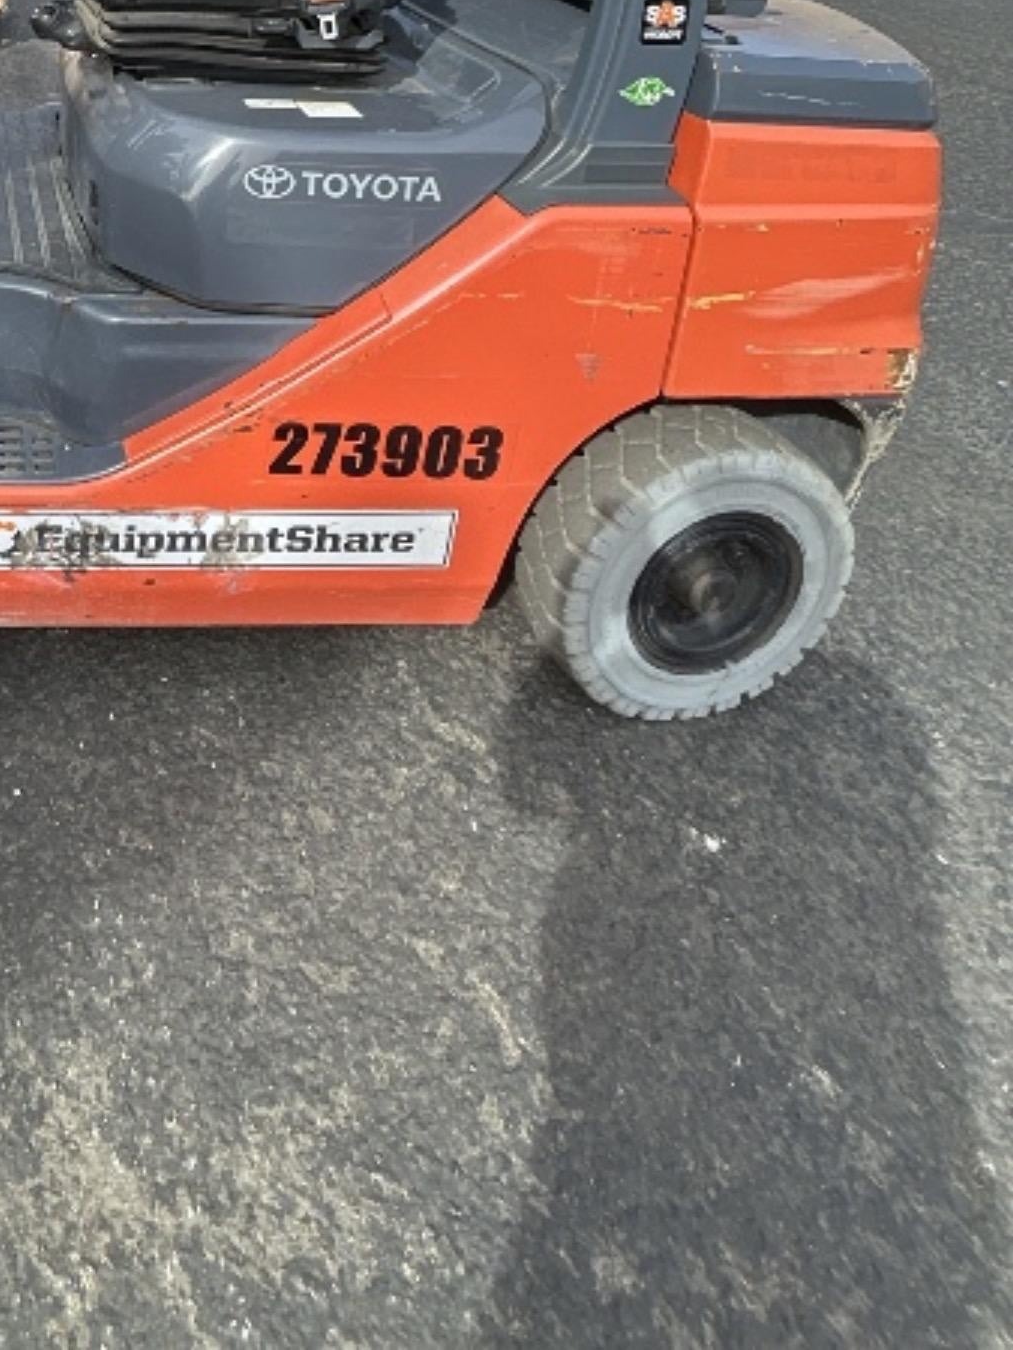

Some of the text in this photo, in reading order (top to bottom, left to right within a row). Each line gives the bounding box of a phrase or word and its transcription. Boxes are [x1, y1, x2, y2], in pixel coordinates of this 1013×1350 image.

[301, 170, 441, 202] TOYOTA
[268, 422, 504, 480] 273903
[36, 523, 416, 559] EquipmentShare
